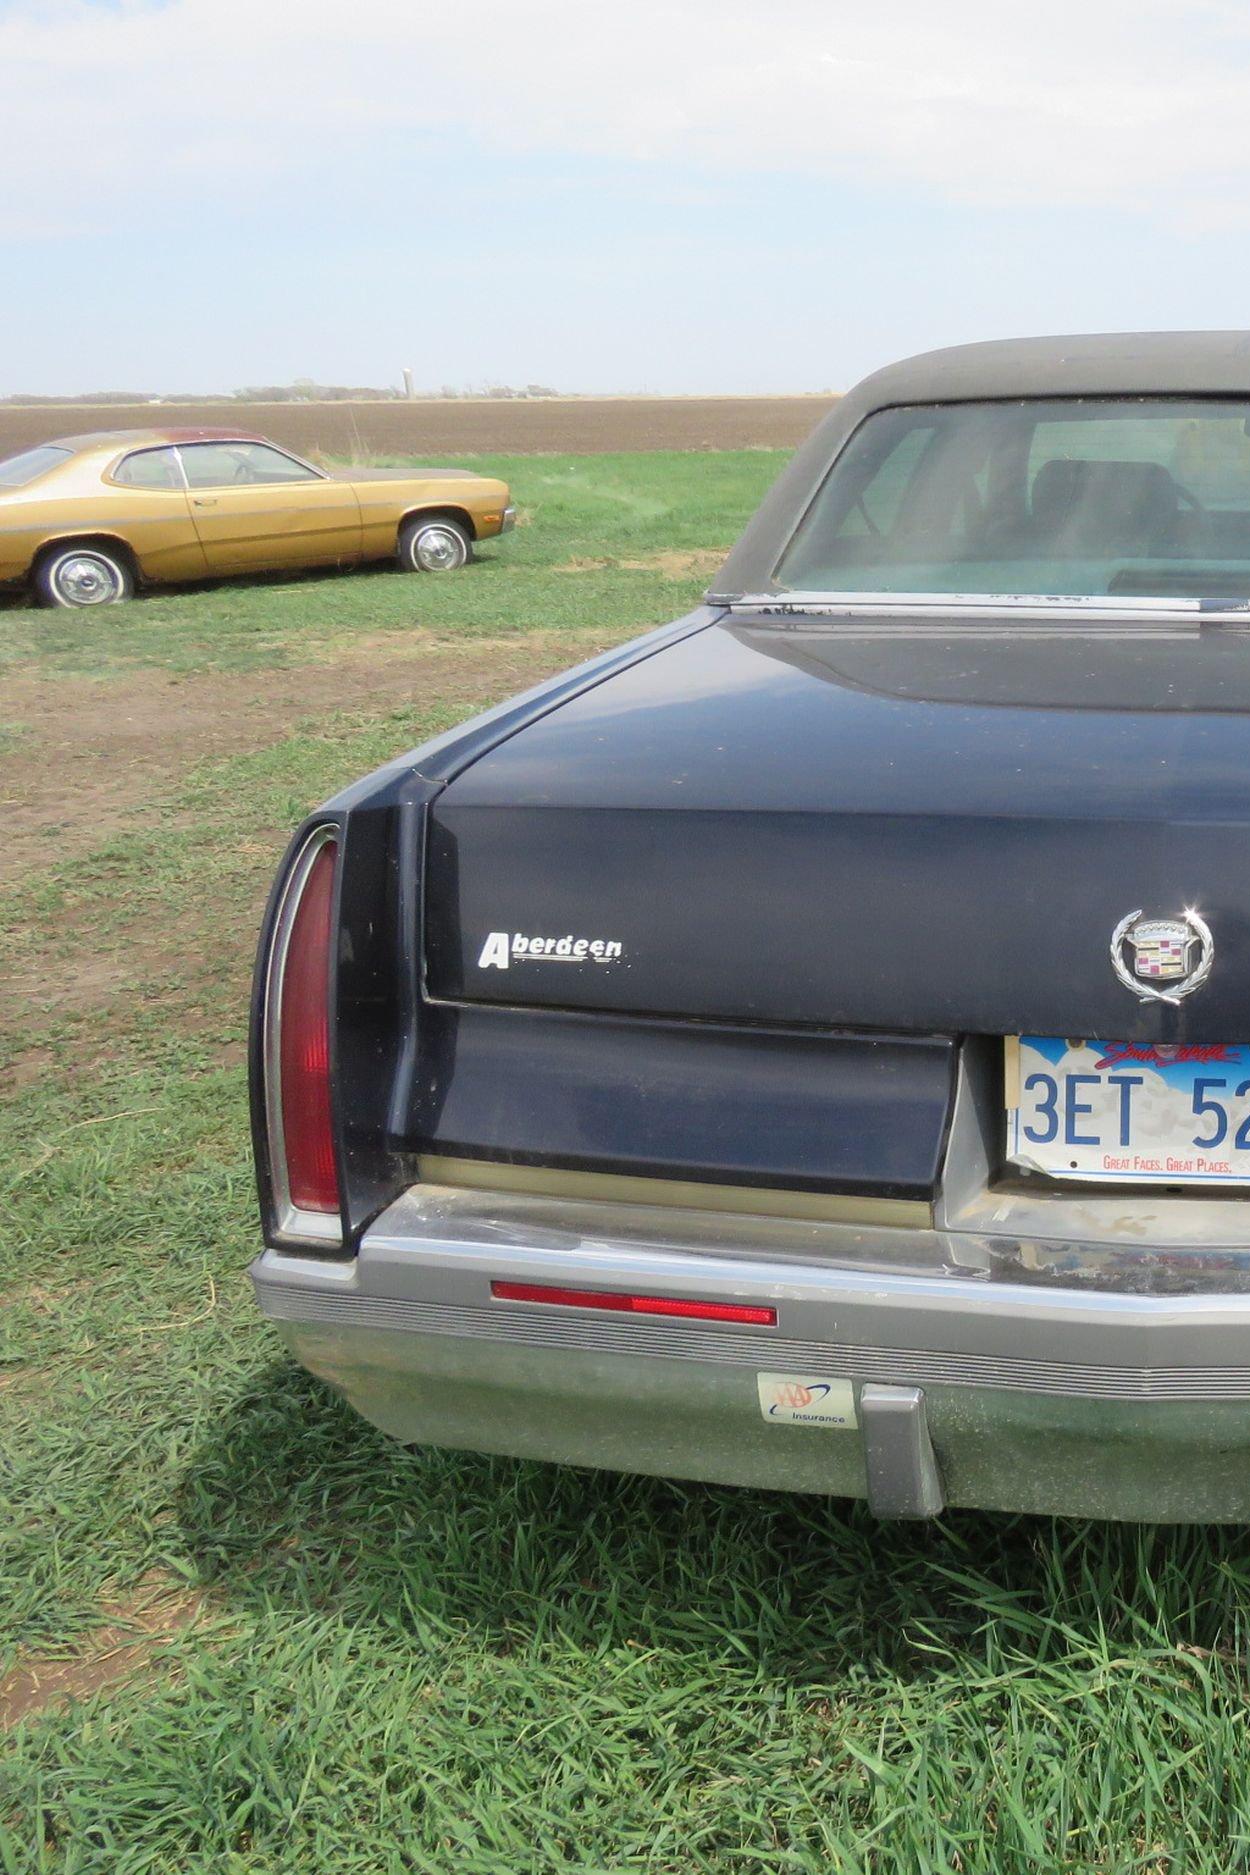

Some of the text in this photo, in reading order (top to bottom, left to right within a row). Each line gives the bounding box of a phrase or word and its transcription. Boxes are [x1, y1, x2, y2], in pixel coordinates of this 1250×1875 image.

[478, 932, 622, 969] Aberdeen
[1023, 1074, 1144, 1147] 3ET
[1103, 1154, 1232, 1173] GREAT FACES. GREAT PLACES.
[792, 1412, 846, 1424] Insurance
